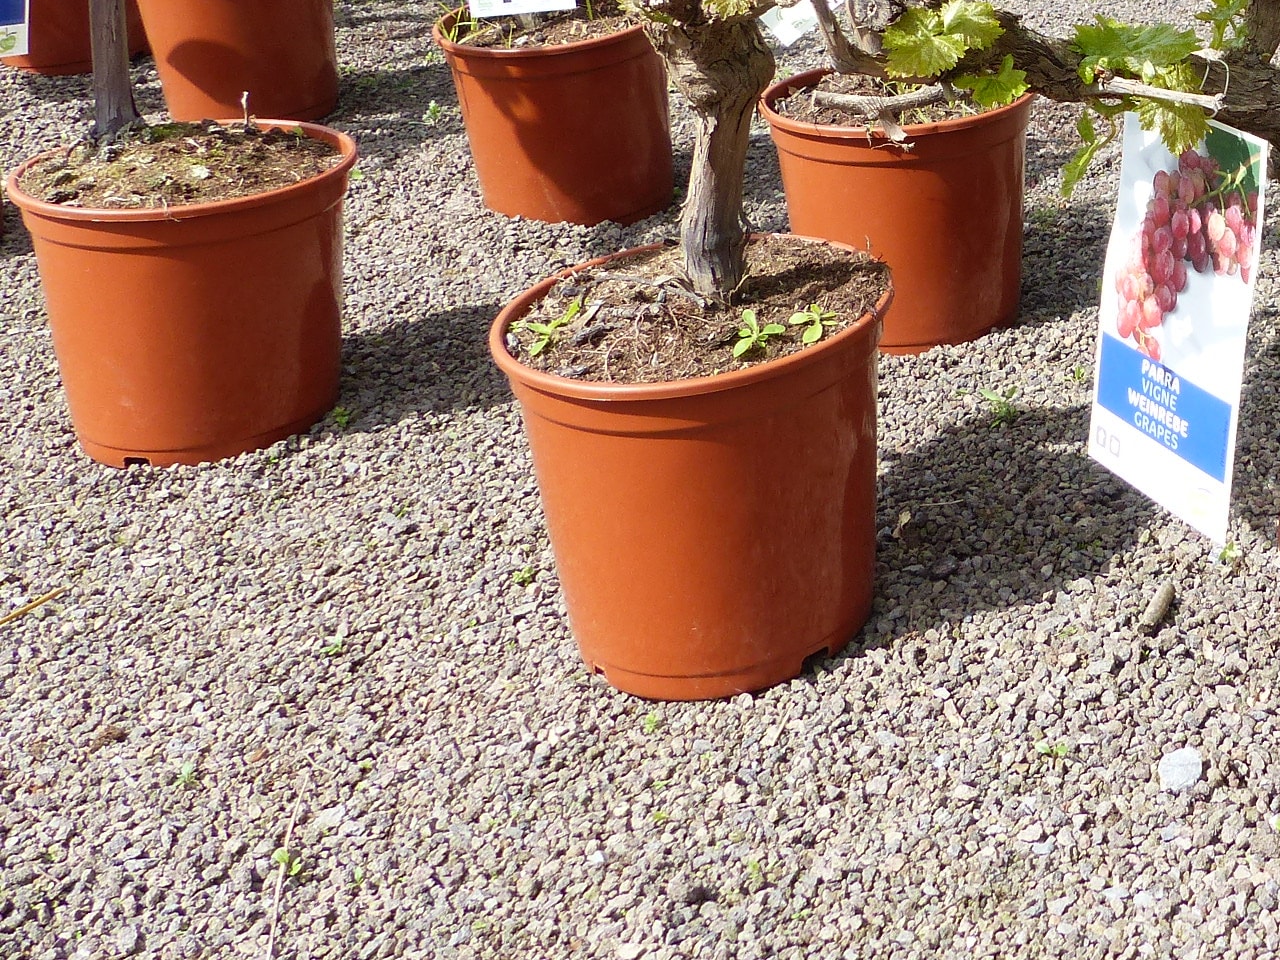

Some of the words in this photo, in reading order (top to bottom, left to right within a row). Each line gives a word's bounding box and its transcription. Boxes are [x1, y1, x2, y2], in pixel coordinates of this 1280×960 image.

[1141, 359, 1180, 395] PARRA
[1142, 377, 1178, 412] VIGNE
[1127, 387, 1189, 438] WEINREBE
[1134, 411, 1179, 450] GRAPES
